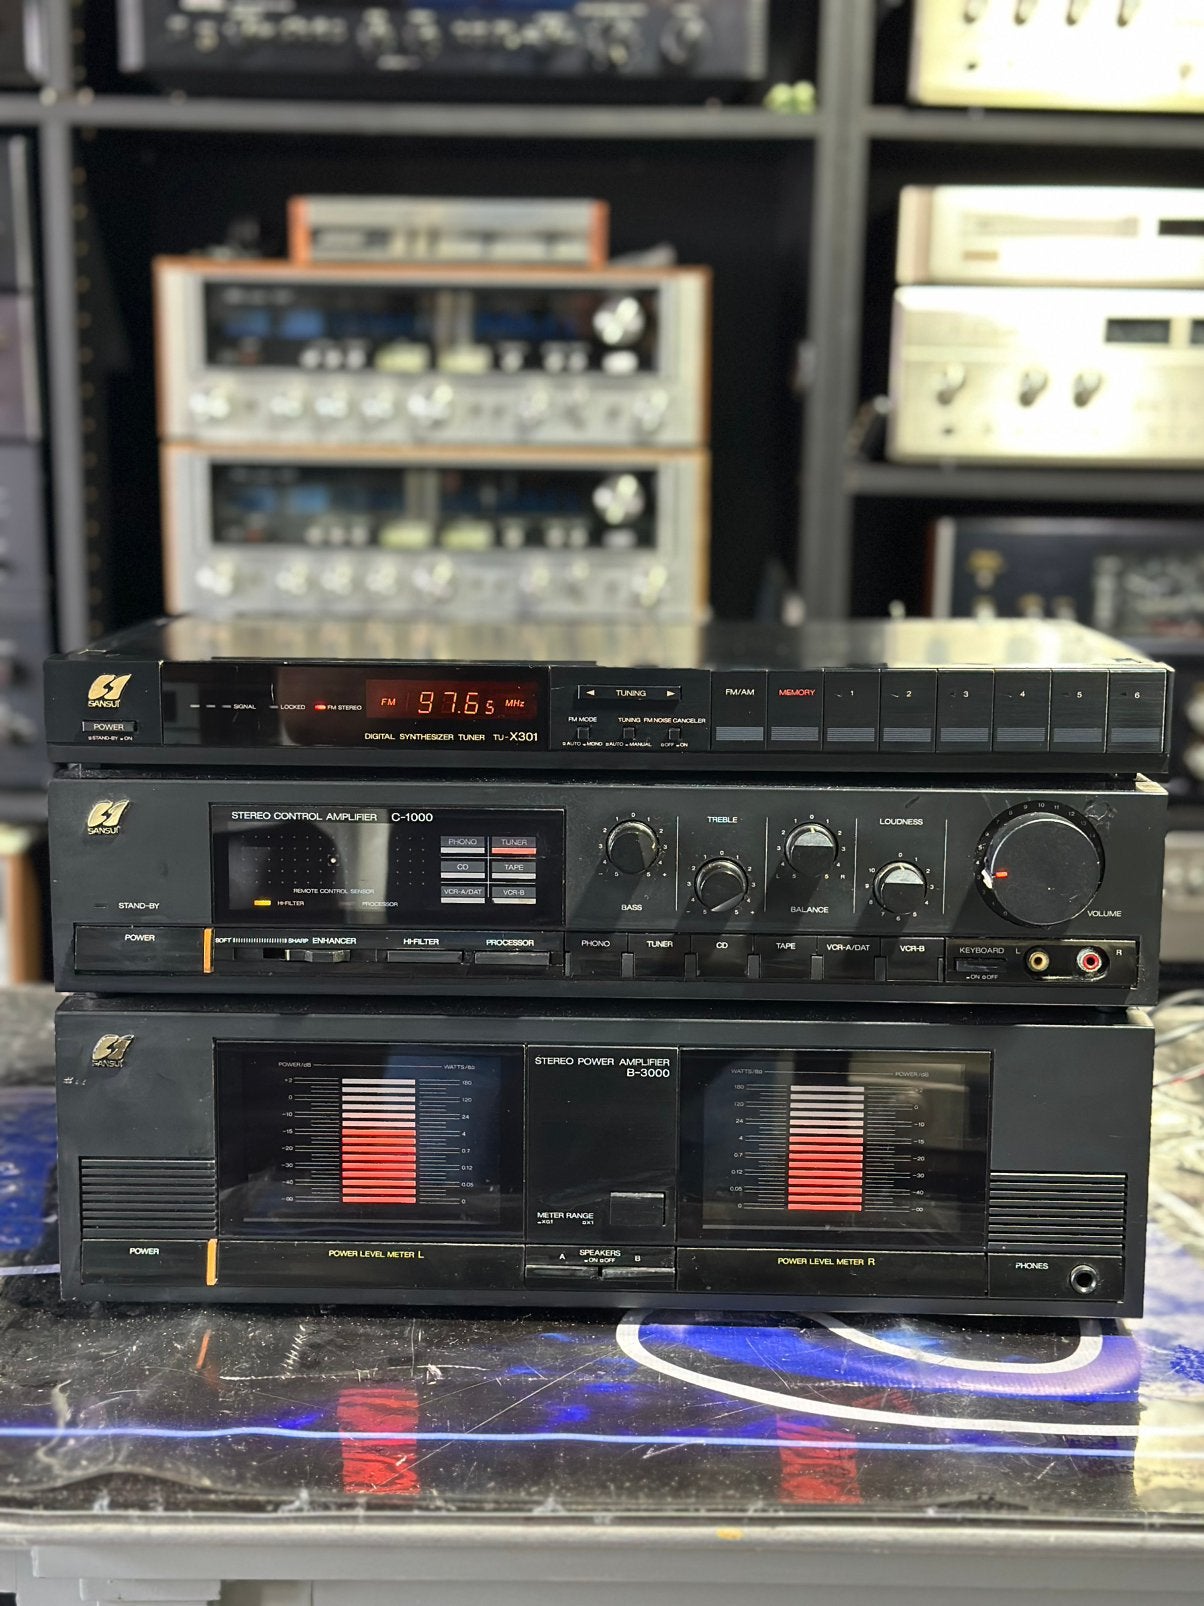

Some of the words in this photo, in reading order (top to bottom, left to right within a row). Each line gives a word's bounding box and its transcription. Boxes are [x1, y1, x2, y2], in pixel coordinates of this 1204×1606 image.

[615, 689, 647, 697] TUNING
[778, 688, 816, 696] MEMORY
[906, 690, 912, 698] 2
[963, 690, 969, 698] 3
[87, 699, 121, 708] SANSUI
[380, 698, 396, 706] FM
[505, 699, 525, 708] MHz
[93, 723, 124, 731] POWER
[364, 732, 395, 741] DIGITAL
[399, 733, 454, 741] SYNTHESIZER
[458, 733, 485, 741] TUNER
[492, 731, 539, 742] TU-X301
[231, 811, 271, 820] STEREO
[273, 812, 323, 821] CONTROL
[325, 813, 378, 821] AMPLIFIER
[391, 812, 433, 822] C-1000
[707, 816, 738, 824] TREBLE
[879, 818, 924, 826] LOUDNESS
[87, 827, 120, 835] SANSUI
[448, 838, 478, 846] PHONO
[790, 906, 829, 914] BALANCE
[312, 937, 357, 945] ENHANCER
[486, 939, 535, 947] PROCESSOR
[646, 940, 673, 948] TUNER
[716, 941, 728, 949] CD
[776, 942, 796, 950] TAPE
[535, 1057, 574, 1065] STEREO
[577, 1057, 615, 1066] POWER
[619, 1058, 670, 1067] AMPLIFIER
[626, 1069, 670, 1078] B-3000
[565, 1212, 594, 1220] RANGE
[129, 1247, 160, 1255] POWER
[418, 1251, 424, 1259] L
[579, 1249, 621, 1257] SPEAKERS
[777, 1257, 808, 1265] POWER
[836, 1258, 865, 1266] METER
[867, 1257, 875, 1266] R
[1015, 1262, 1049, 1270] PHONES
